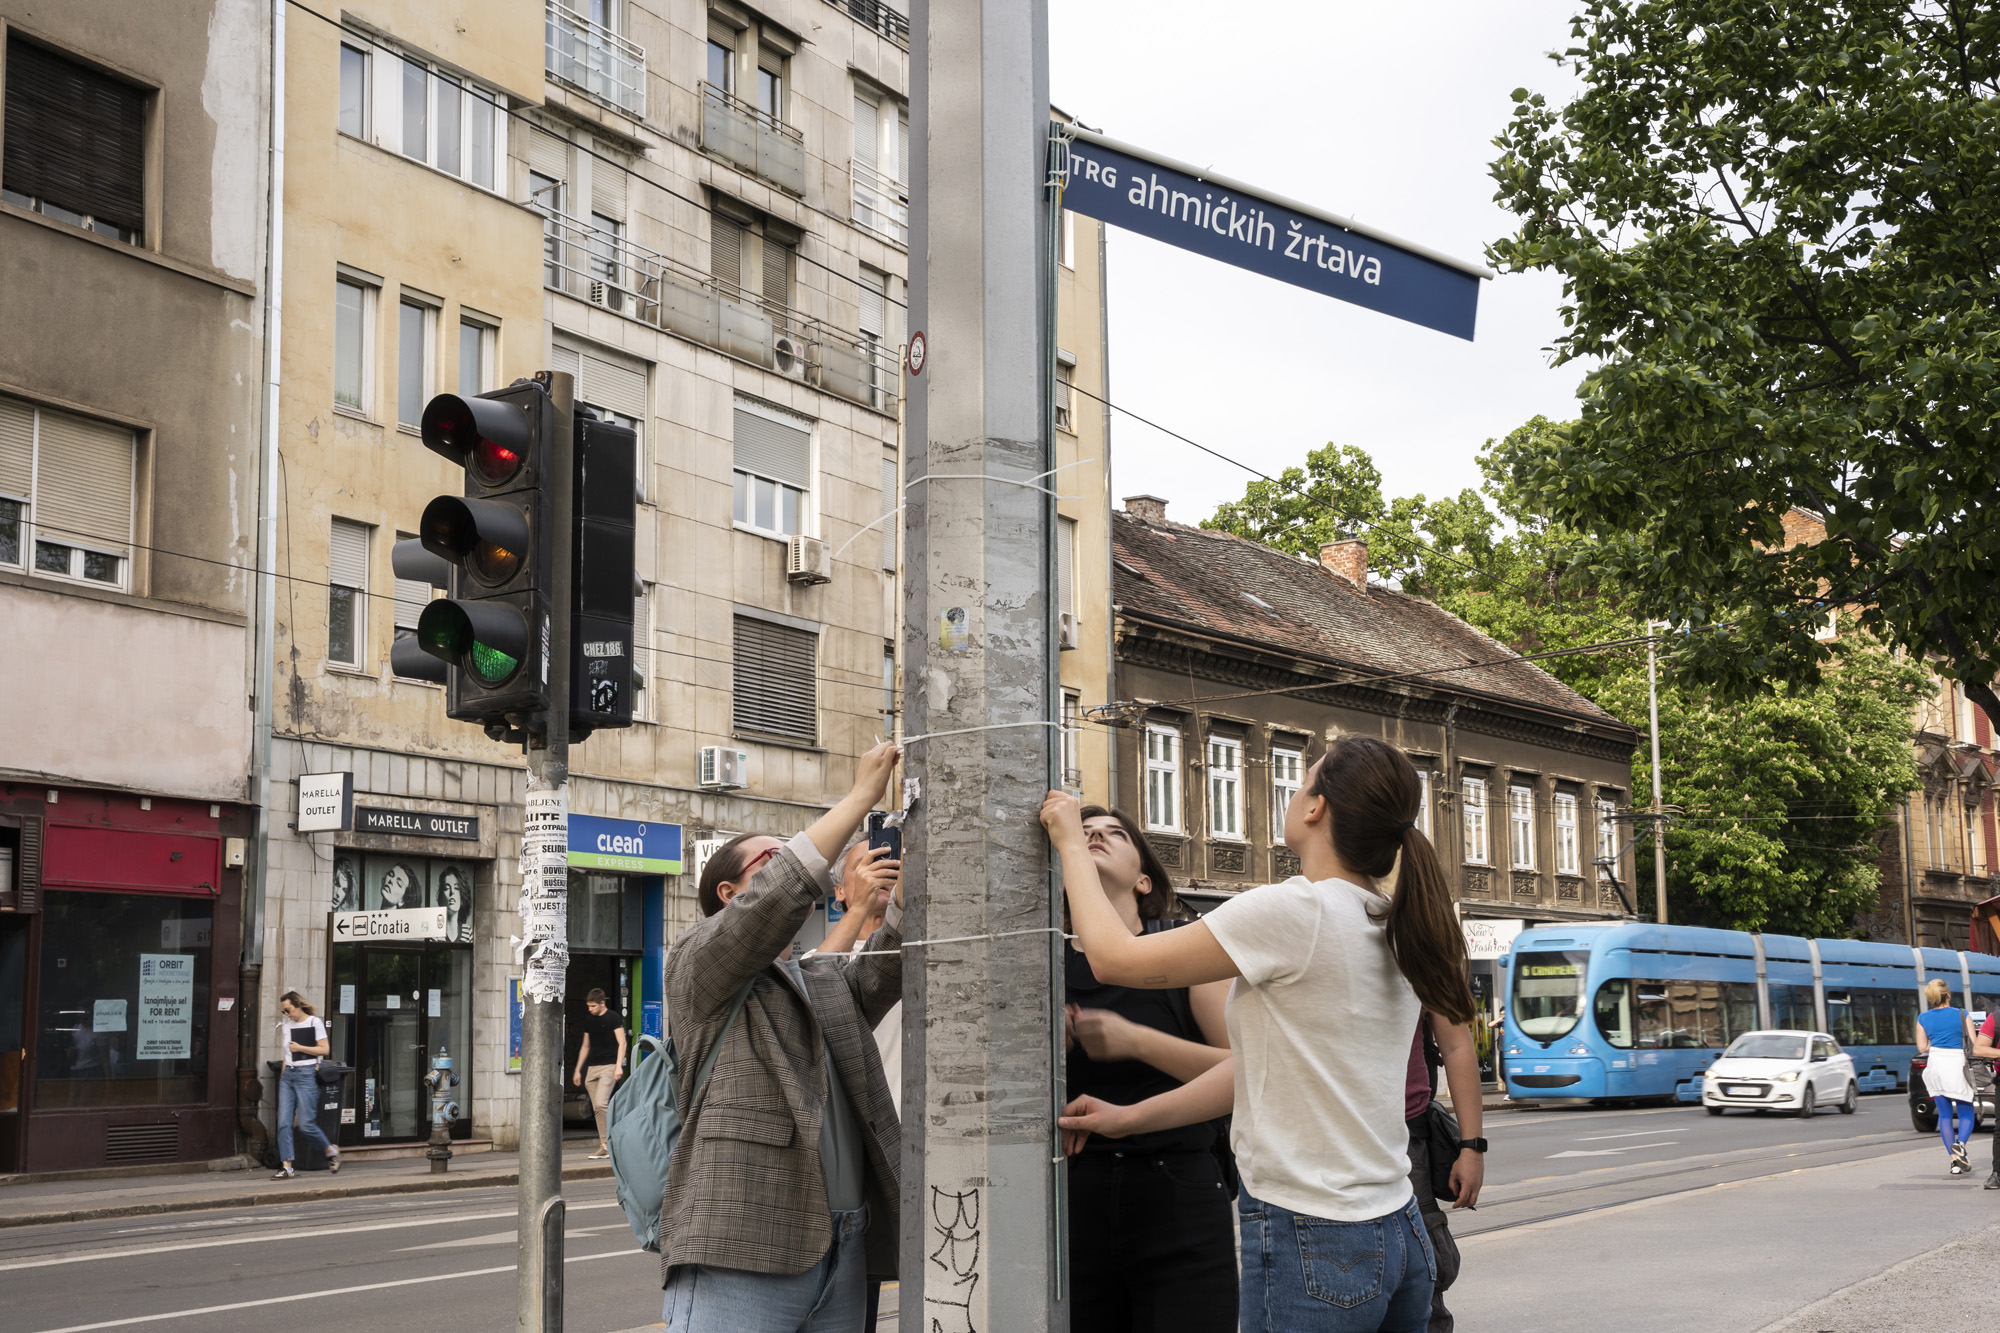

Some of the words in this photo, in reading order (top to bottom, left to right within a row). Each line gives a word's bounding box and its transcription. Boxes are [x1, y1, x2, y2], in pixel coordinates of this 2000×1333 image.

[1070, 153, 1117, 189] TRG
[1128, 173, 1275, 251] ahmićkih
[1283, 220, 1382, 286] žrtava
[583, 643, 604, 656] CHEZ
[605, 642, 621, 655] 186
[302, 789, 341, 799] MARELLA
[305, 805, 336, 816] OUTLET
[367, 813, 421, 830] MARELLA
[430, 818, 469, 834] OUTLET
[597, 857, 644, 870] EXPRESS
[370, 920, 410, 936] Croatia
[159, 960, 184, 969] ORBIT
[149, 1008, 163, 1016] FOR
[164, 1008, 180, 1016] RENT
